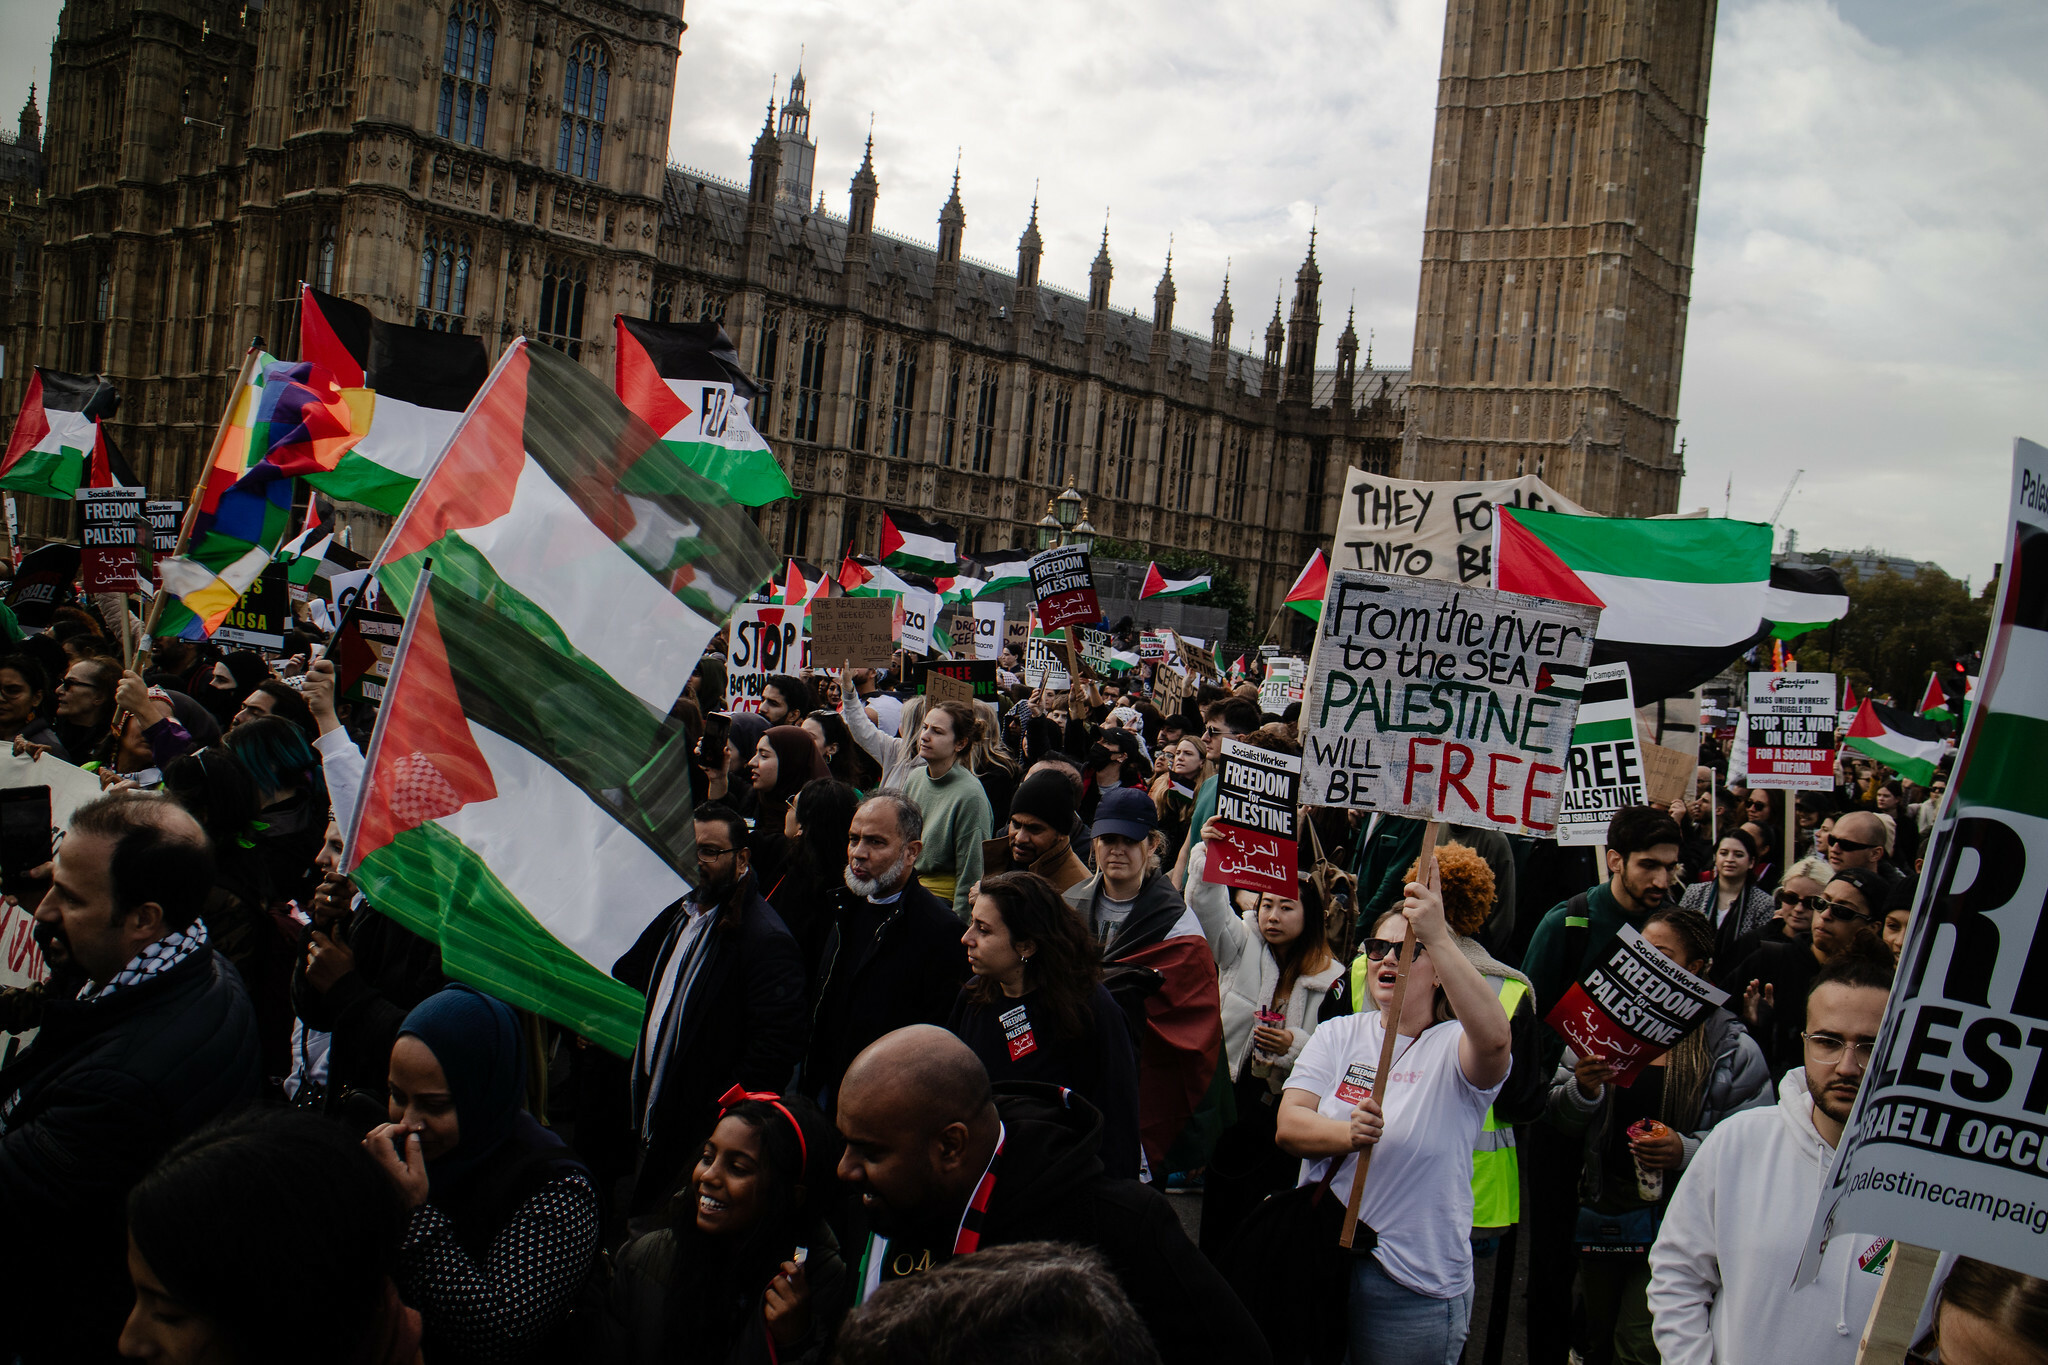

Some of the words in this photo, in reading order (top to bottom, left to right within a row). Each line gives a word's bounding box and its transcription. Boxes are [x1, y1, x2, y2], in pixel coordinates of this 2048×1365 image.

[84, 502, 140, 520] FREEDOM
[1351, 483, 1433, 533] THEY
[83, 527, 137, 545] PALESTIN
[1344, 541, 1433, 576] INTO
[1034, 556, 1084, 581] FREEDOM
[1036, 574, 1091, 600] PALESTINE
[816, 600, 831, 609] THE
[835, 600, 857, 609] REAL
[1048, 593, 1085, 609] الحرية
[816, 612, 832, 620] THIS
[838, 610, 874, 619] WEEKEND
[878, 610, 886, 618] IS
[1049, 605, 1092, 626] لفلسطين
[1334, 582, 1430, 643] From
[1436, 592, 1484, 646] the
[1488, 610, 1582, 658] river
[816, 623, 832, 631] THE
[836, 622, 866, 631] ETHNIC
[955, 620, 975, 632] DRO
[1084, 629, 1107, 644] STOP
[732, 620, 796, 674] STOP
[1089, 643, 1105, 659] THE
[1339, 635, 1387, 671] to
[1396, 643, 1457, 681] the
[1462, 650, 1529, 687] SEA
[1593, 668, 1626, 681] Campaign
[1779, 677, 1818, 685] Socialist
[933, 677, 965, 701] FREE
[1264, 683, 1288, 696] FRE
[1320, 669, 1562, 754] PALESTINE
[1772, 705, 1802, 713] STRUGGLE
[1804, 705, 1812, 713] TO
[1750, 715, 1780, 731] STOP
[1782, 716, 1804, 731] THE
[1805, 717, 1834, 732] WAR
[1765, 731, 1782, 746] ON
[1784, 732, 1818, 747] GAZA!
[1311, 735, 1381, 770] WILL
[1756, 748, 1773, 760] FOR
[1774, 749, 1781, 760] A
[1783, 749, 1827, 761] SOCIALIST
[1569, 741, 1641, 788] REE
[1772, 761, 1812, 773] INTIFADA
[1224, 761, 1290, 800] FREEDOM
[1325, 769, 1379, 806] BE
[1403, 737, 1564, 830] FREE
[1751, 778, 1819, 786] socialistparty.org.uk
[1248, 790, 1260, 804] for
[1563, 786, 1643, 811] ALESTINE
[1217, 794, 1293, 835] PALESTINE
[1571, 811, 1598, 822] ISRAELI
[1228, 830, 1279, 858] الحرية
[1219, 855, 1287, 882] لفلسطين
[1608, 947, 1703, 1021] FREEDOM
[1584, 969, 1684, 1046] PALESTINE
[1633, 993, 1650, 1009] for
[1002, 1012, 1028, 1029] FREEDOM
[1005, 1021, 1032, 1040] PALESTINE
[1581, 1006, 1642, 1056] الحرية
